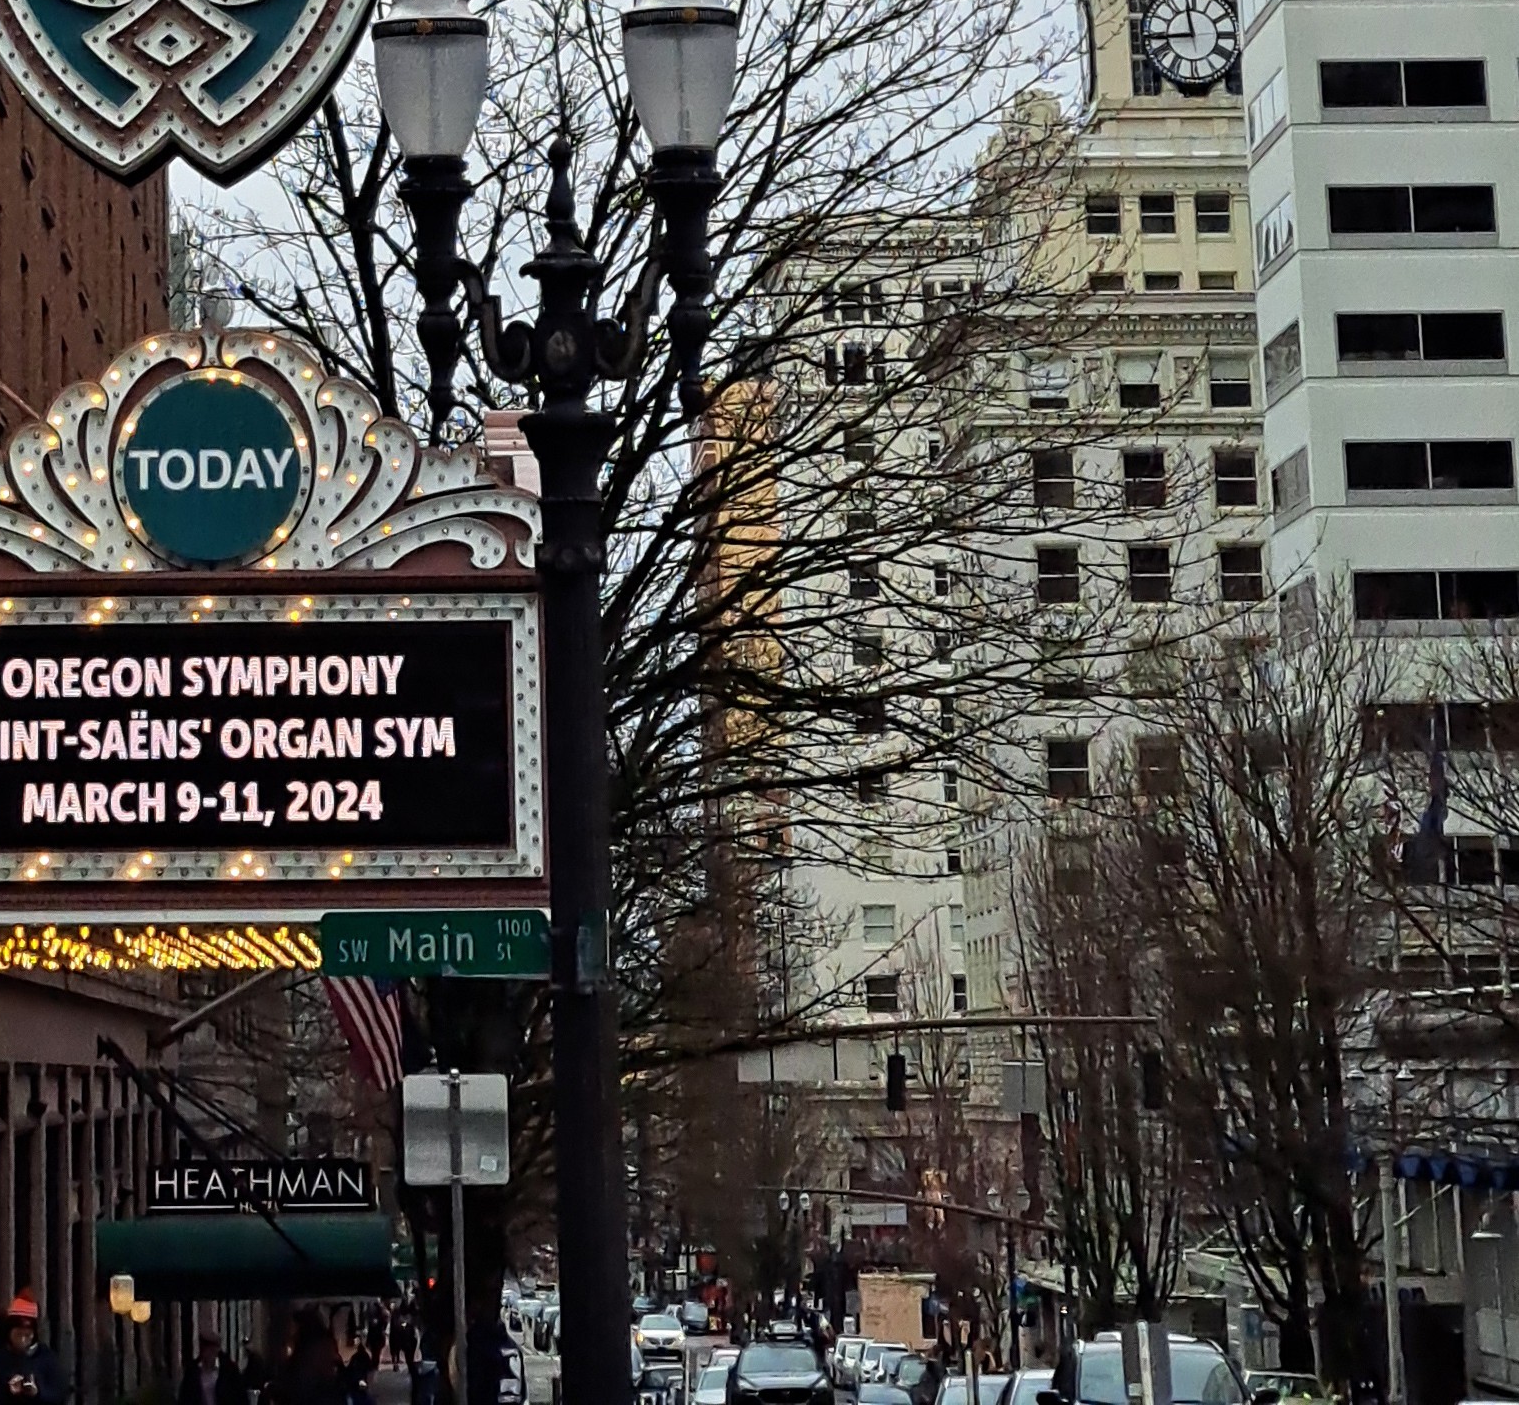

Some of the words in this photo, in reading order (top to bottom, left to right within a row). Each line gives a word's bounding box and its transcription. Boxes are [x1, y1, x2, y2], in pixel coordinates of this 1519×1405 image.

[127, 447, 295, 491] TODAY
[1, 657, 171, 699] OREGON
[181, 655, 405, 697] SYMPHONY
[220, 717, 363, 760] ORGAN
[374, 716, 457, 758] SYM
[22, 781, 167, 824] MARCH
[177, 781, 276, 827] 9-11,
[285, 779, 384, 822] 2024
[338, 939, 369, 963] SW
[388, 922, 475, 963] Main
[497, 918, 532, 937] 1100
